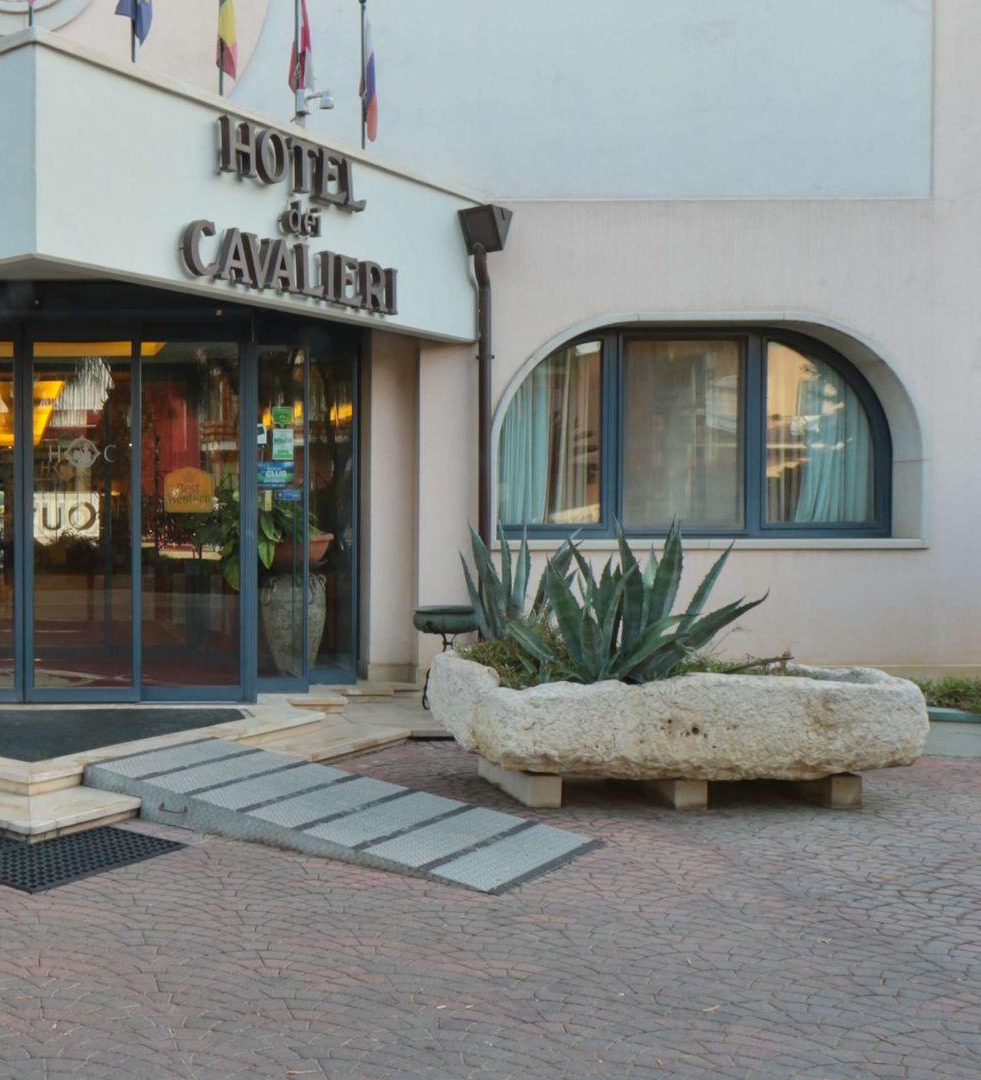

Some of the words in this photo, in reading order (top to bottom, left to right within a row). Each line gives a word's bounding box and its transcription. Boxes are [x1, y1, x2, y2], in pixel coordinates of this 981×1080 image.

[218, 115, 366, 213] HOTEL
[182, 219, 397, 315] CAVALIERI
[279, 200, 321, 238] dei
